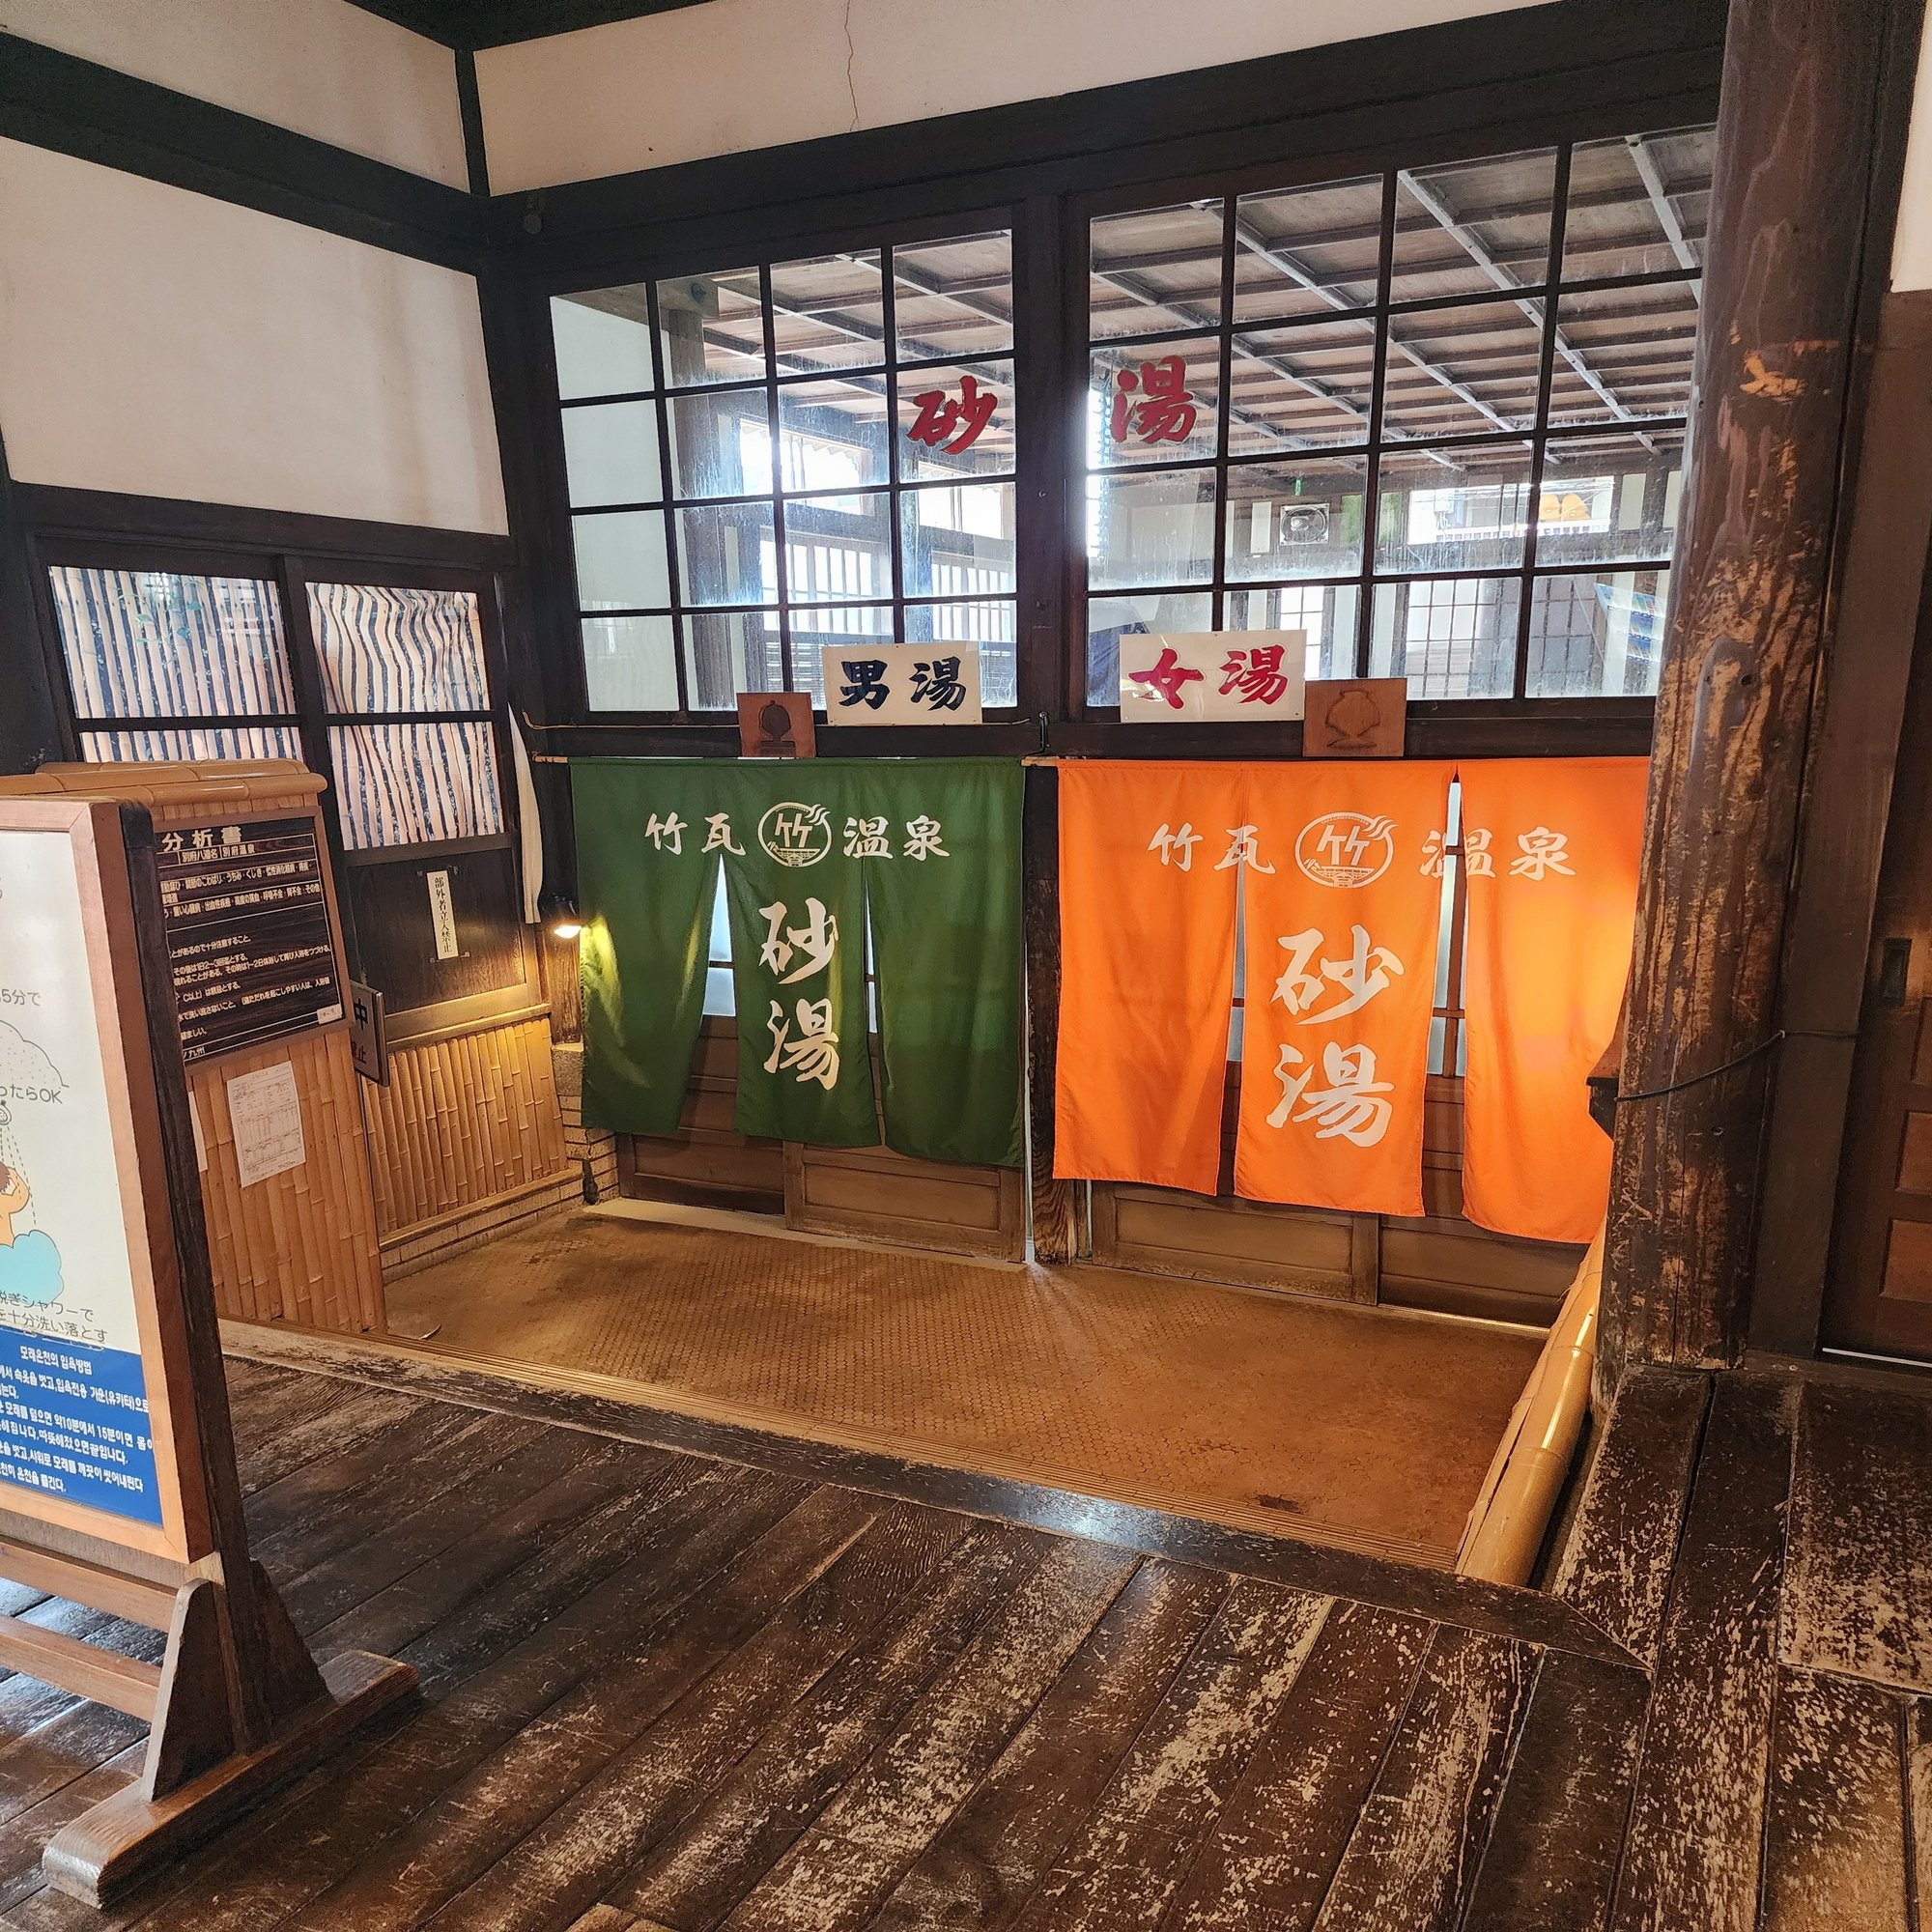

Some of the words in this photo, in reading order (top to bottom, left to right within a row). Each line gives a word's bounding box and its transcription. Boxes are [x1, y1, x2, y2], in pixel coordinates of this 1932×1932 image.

[838, 656, 967, 711] 男湯
[1128, 644, 1289, 710] 女湯
[161, 825, 242, 852] 分析書
[434, 876, 452, 952] 部外者立入禁止
[0, 988, 41, 1007] 5分で
[758, 896, 840, 1091] 砂湯
[1265, 924, 1405, 1148] 砂湯
[0, 1383, 19, 1399] 는다.
